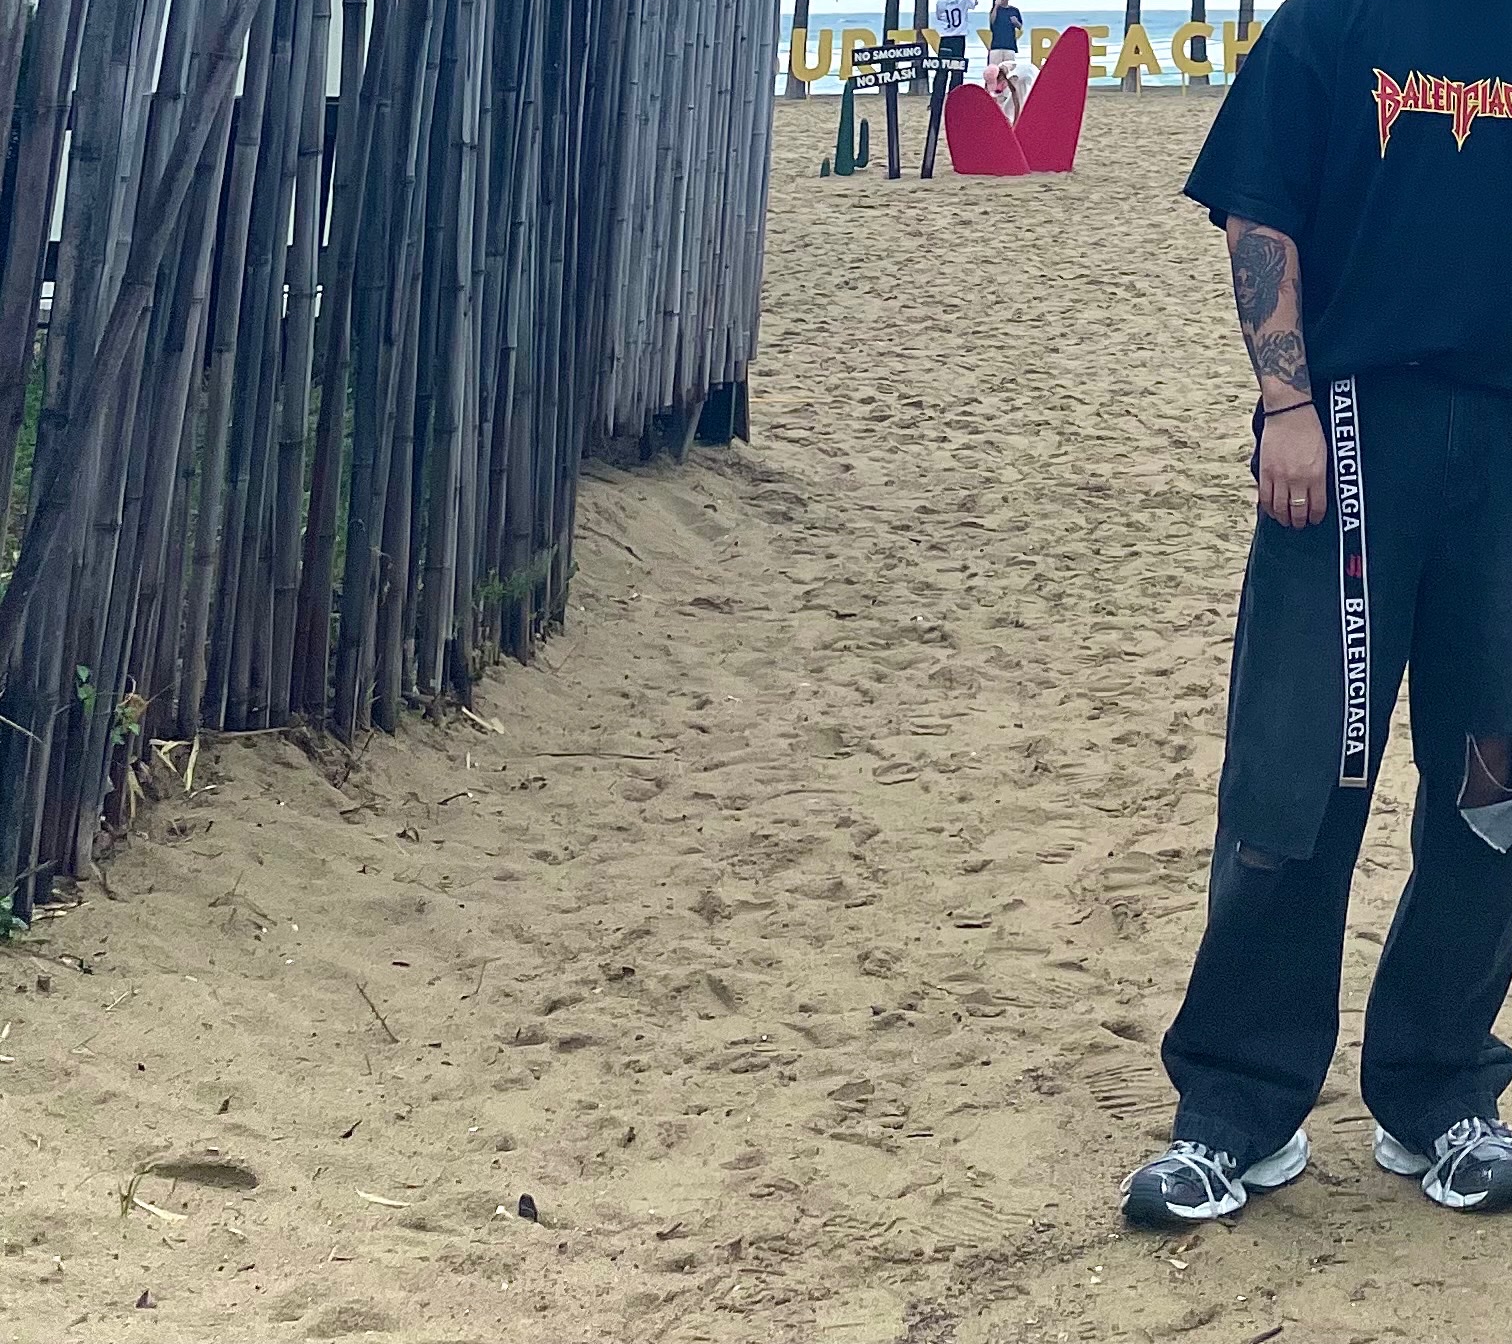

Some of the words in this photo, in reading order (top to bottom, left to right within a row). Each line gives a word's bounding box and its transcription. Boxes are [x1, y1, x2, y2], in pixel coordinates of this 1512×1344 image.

[945, 7, 962, 29] 10
[854, 51, 871, 62] NO
[872, 46, 922, 61] SMOKING
[922, 58, 940, 69] NO
[856, 74, 875, 87] NO
[876, 67, 916, 84] TRASH
[1334, 378, 1361, 533] BALENCIAGA
[1345, 597, 1366, 756] BALENCIAGA
